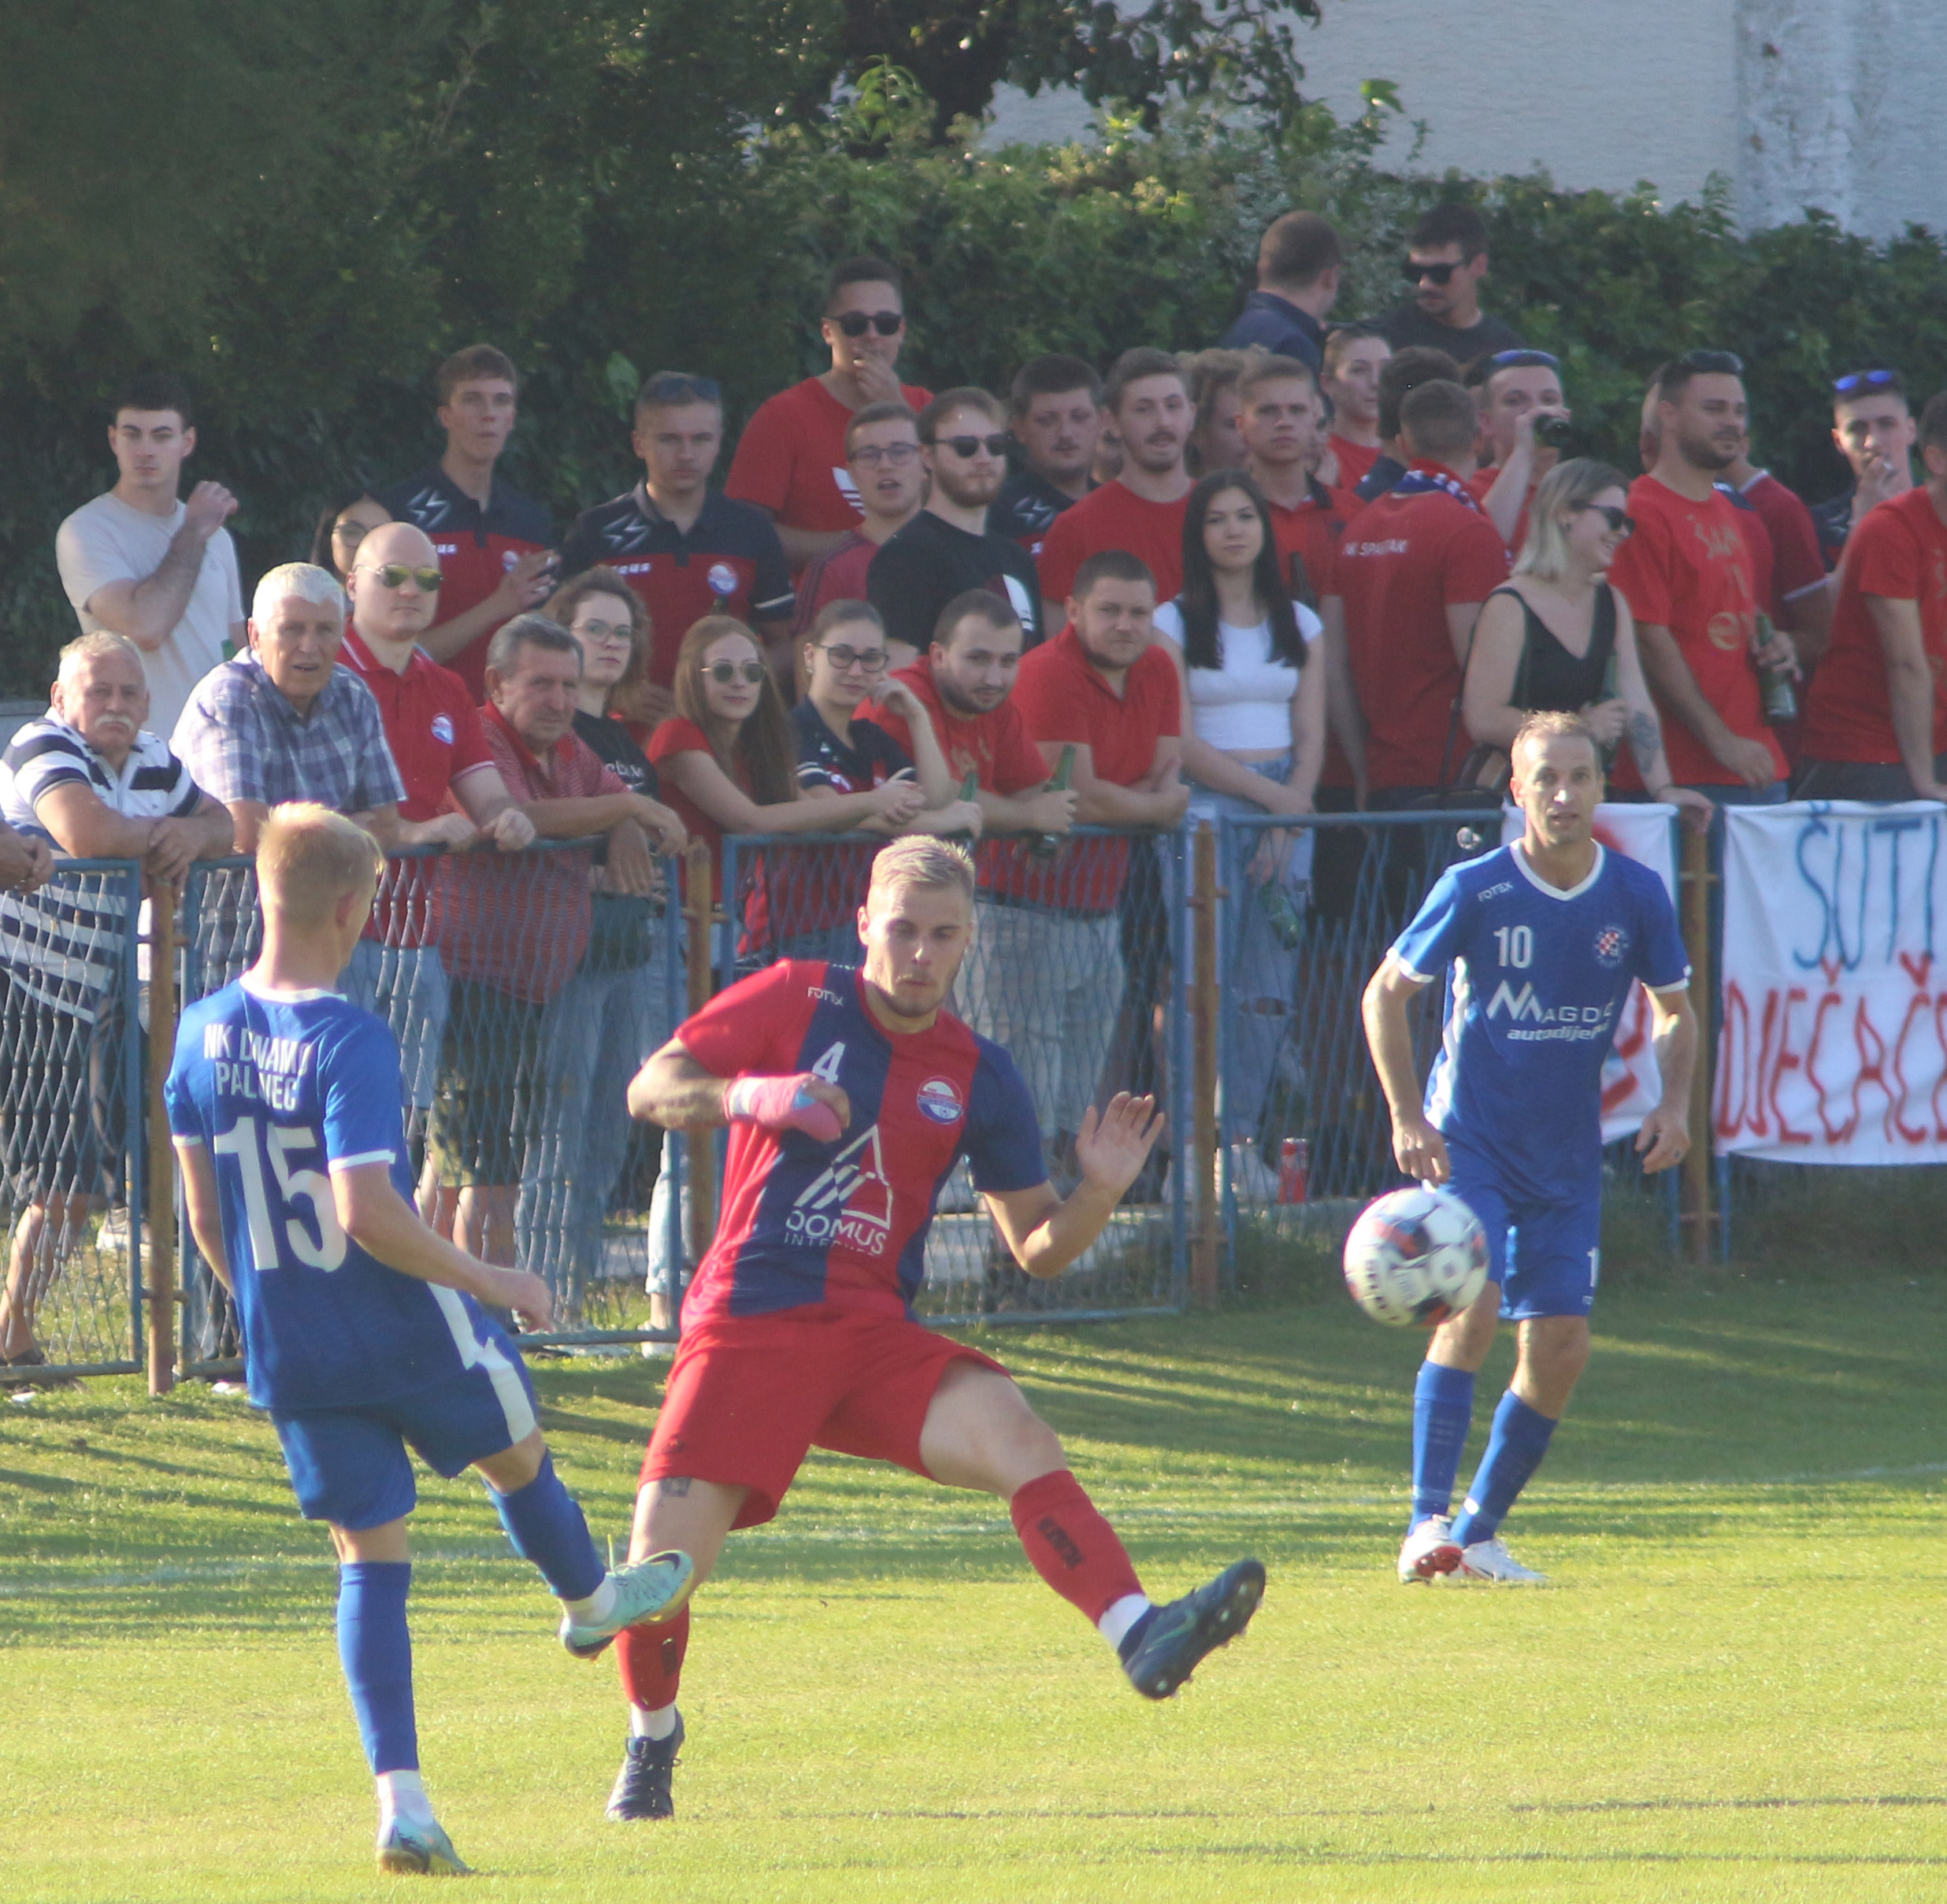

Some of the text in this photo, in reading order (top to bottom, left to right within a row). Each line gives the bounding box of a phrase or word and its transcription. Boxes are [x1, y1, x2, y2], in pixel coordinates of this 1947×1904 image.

[1493, 924, 1533, 969] 10
[204, 1024, 232, 1059] NK
[811, 1041, 845, 1084] 4
[213, 1117, 347, 1273] 15
[785, 1209, 888, 1254] DOMUS
